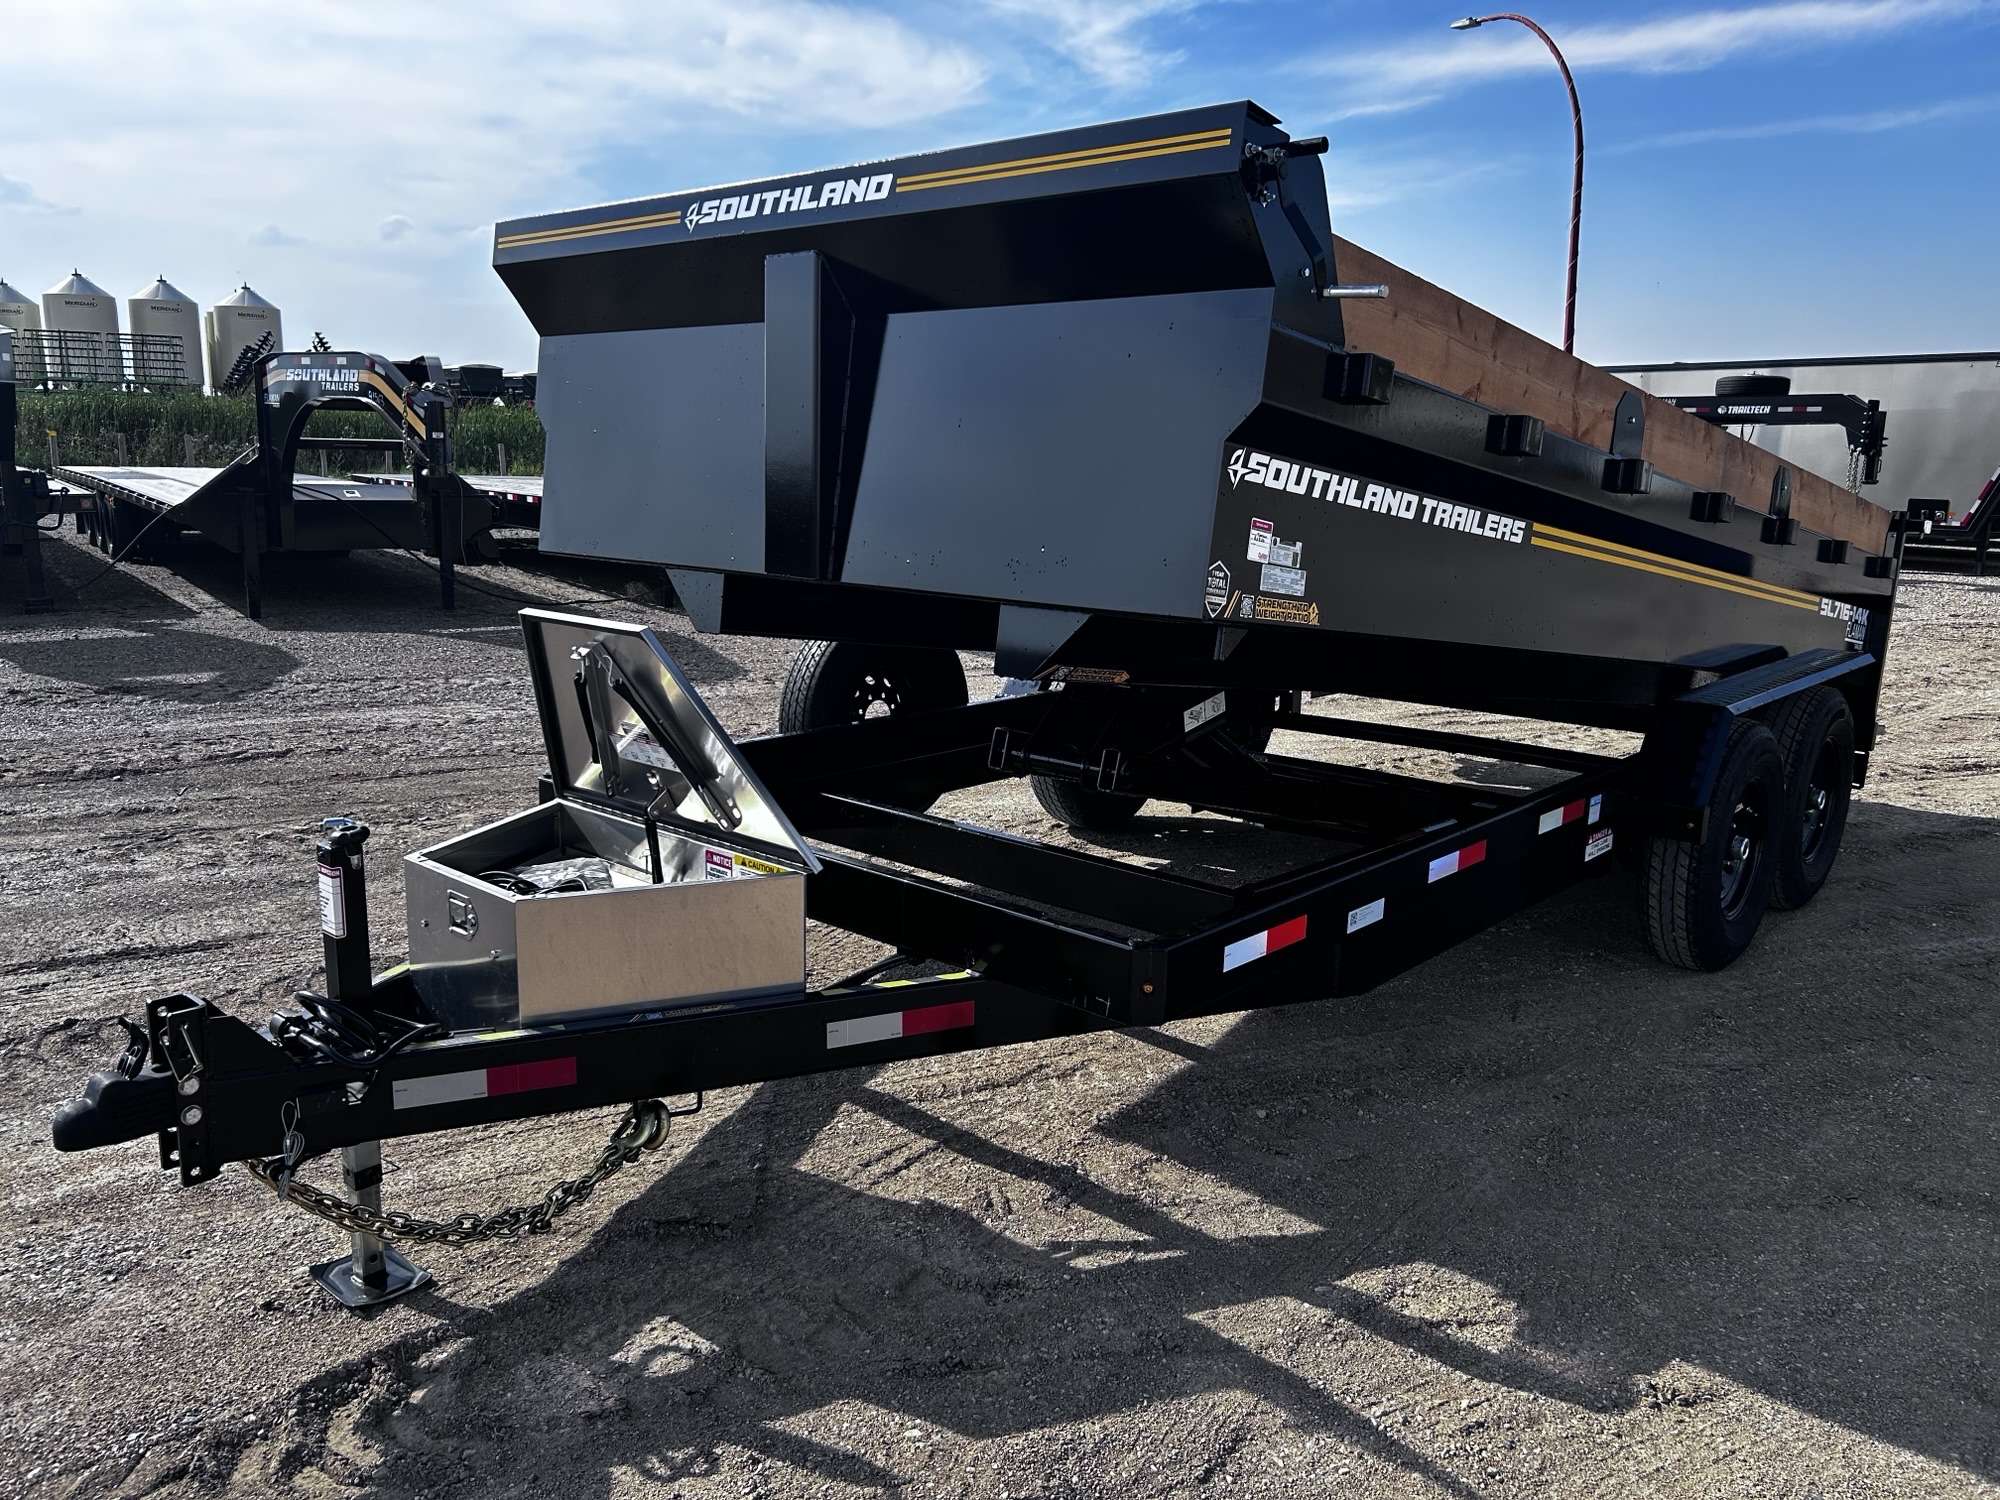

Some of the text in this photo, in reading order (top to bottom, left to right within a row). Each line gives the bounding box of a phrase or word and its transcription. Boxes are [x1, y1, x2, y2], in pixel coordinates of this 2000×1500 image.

[698, 173, 894, 224] SOUTHLAND
[286, 369, 359, 381] SOUTHLAND
[321, 382, 360, 391] TRAILERS
[1728, 405, 1771, 414] TRAILTECH
[1247, 452, 1526, 544] SOUTHLAND TRAILERS
[1208, 577, 1226, 589] TOTAL
[1256, 608, 1310, 622] WEIGHT RATIO
[712, 855, 732, 867] NOTICE
[748, 861, 775, 873] CAUTION
